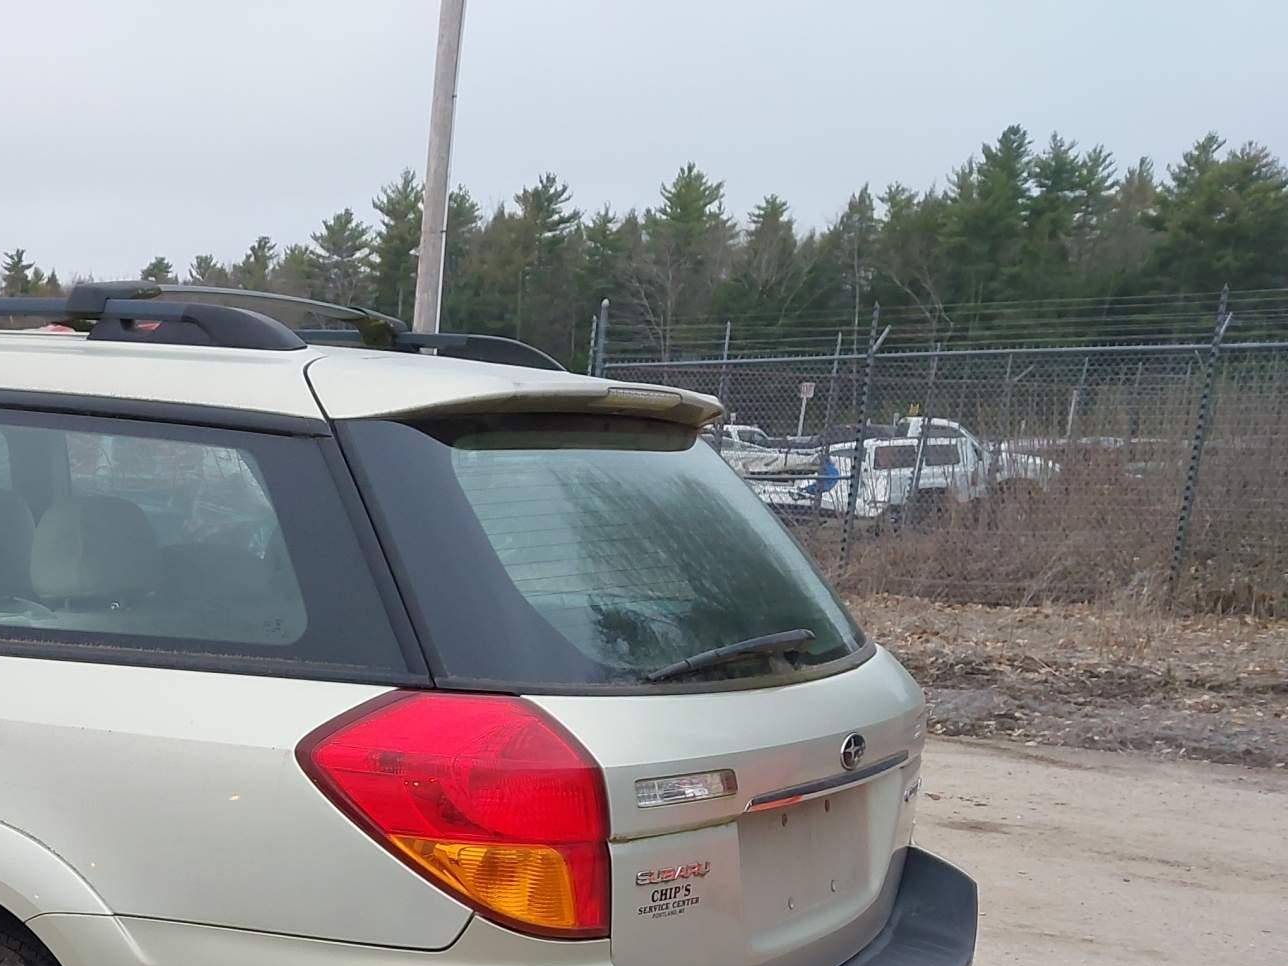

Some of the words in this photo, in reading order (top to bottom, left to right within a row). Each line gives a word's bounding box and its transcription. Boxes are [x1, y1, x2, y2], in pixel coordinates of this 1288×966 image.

[636, 861, 711, 886] SUBARU
[651, 884, 691, 903] CHIP'S
[638, 903, 670, 915] SERVICE
[672, 897, 700, 909] CENTER
